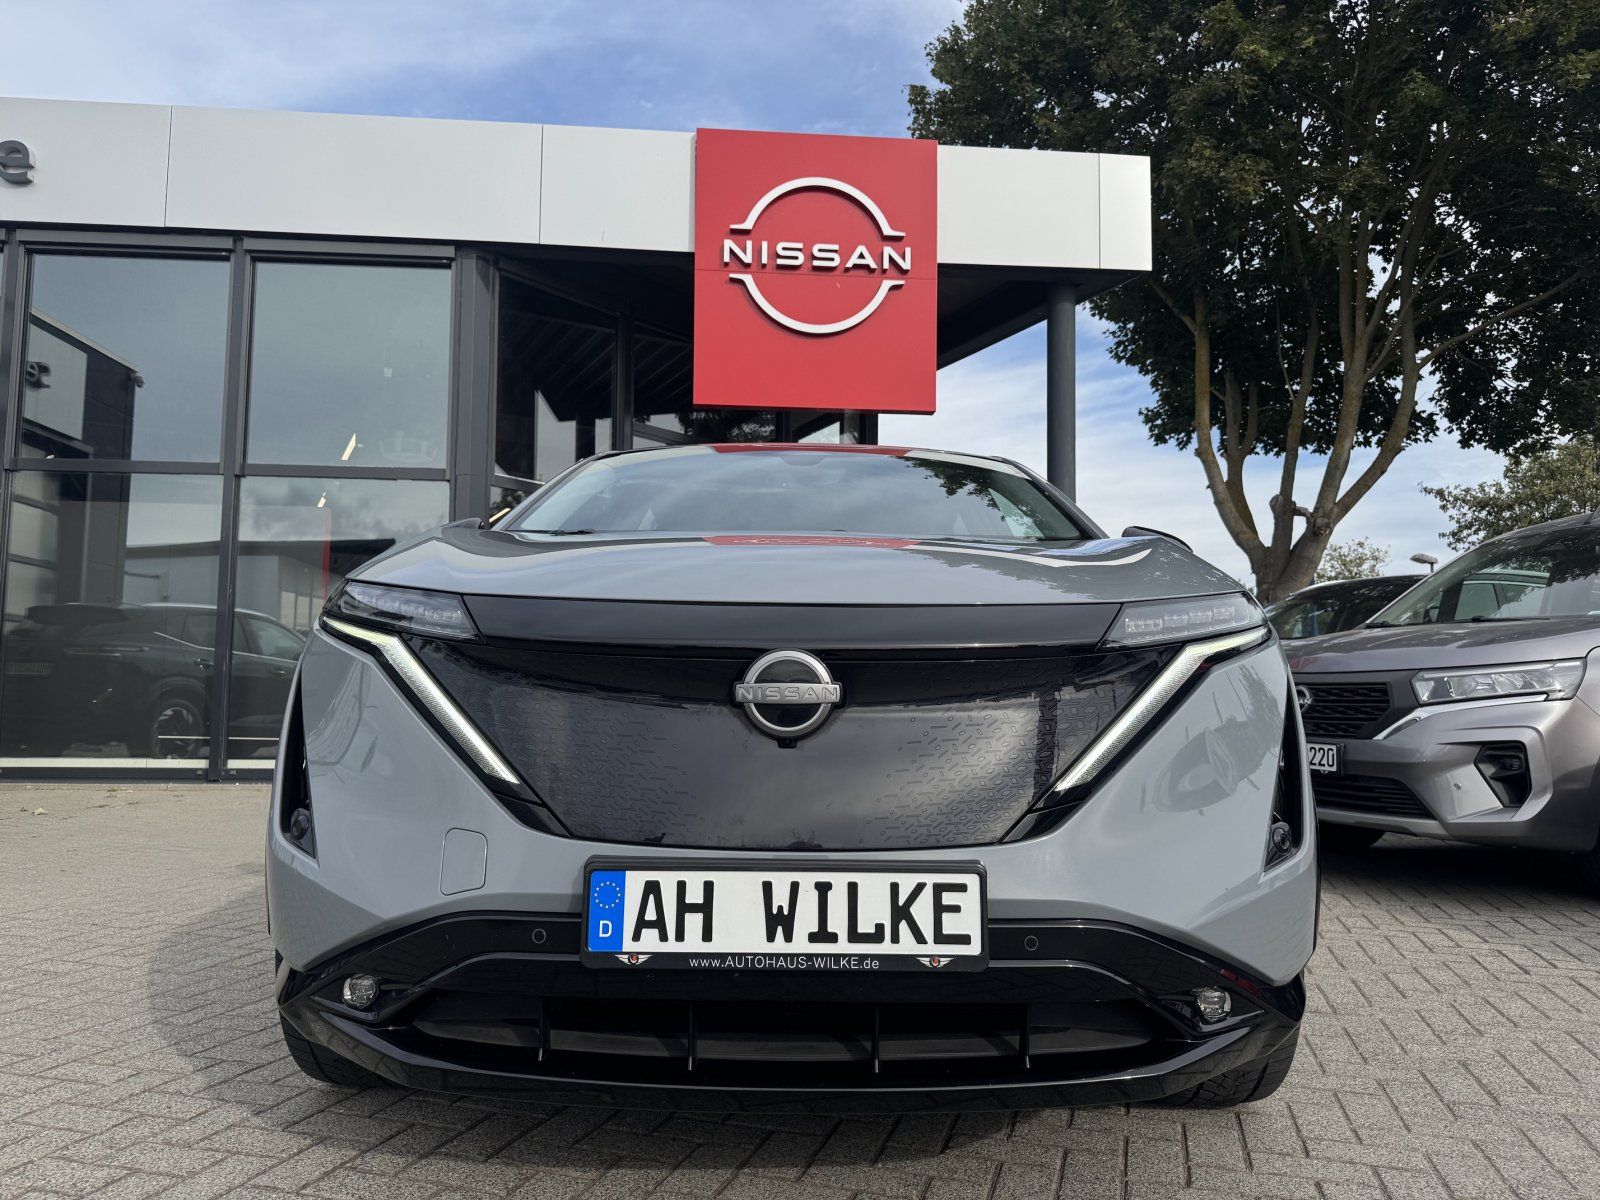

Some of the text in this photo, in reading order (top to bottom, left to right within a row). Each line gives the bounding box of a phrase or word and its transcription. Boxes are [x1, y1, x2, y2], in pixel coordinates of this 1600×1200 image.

[723, 239, 912, 273] NISSAN
[738, 686, 839, 701] NISSAN
[631, 880, 972, 945] AH WILKE
[598, 920, 613, 938] D
[689, 955, 880, 970] www.AUTOHAUS-WILKE.de
